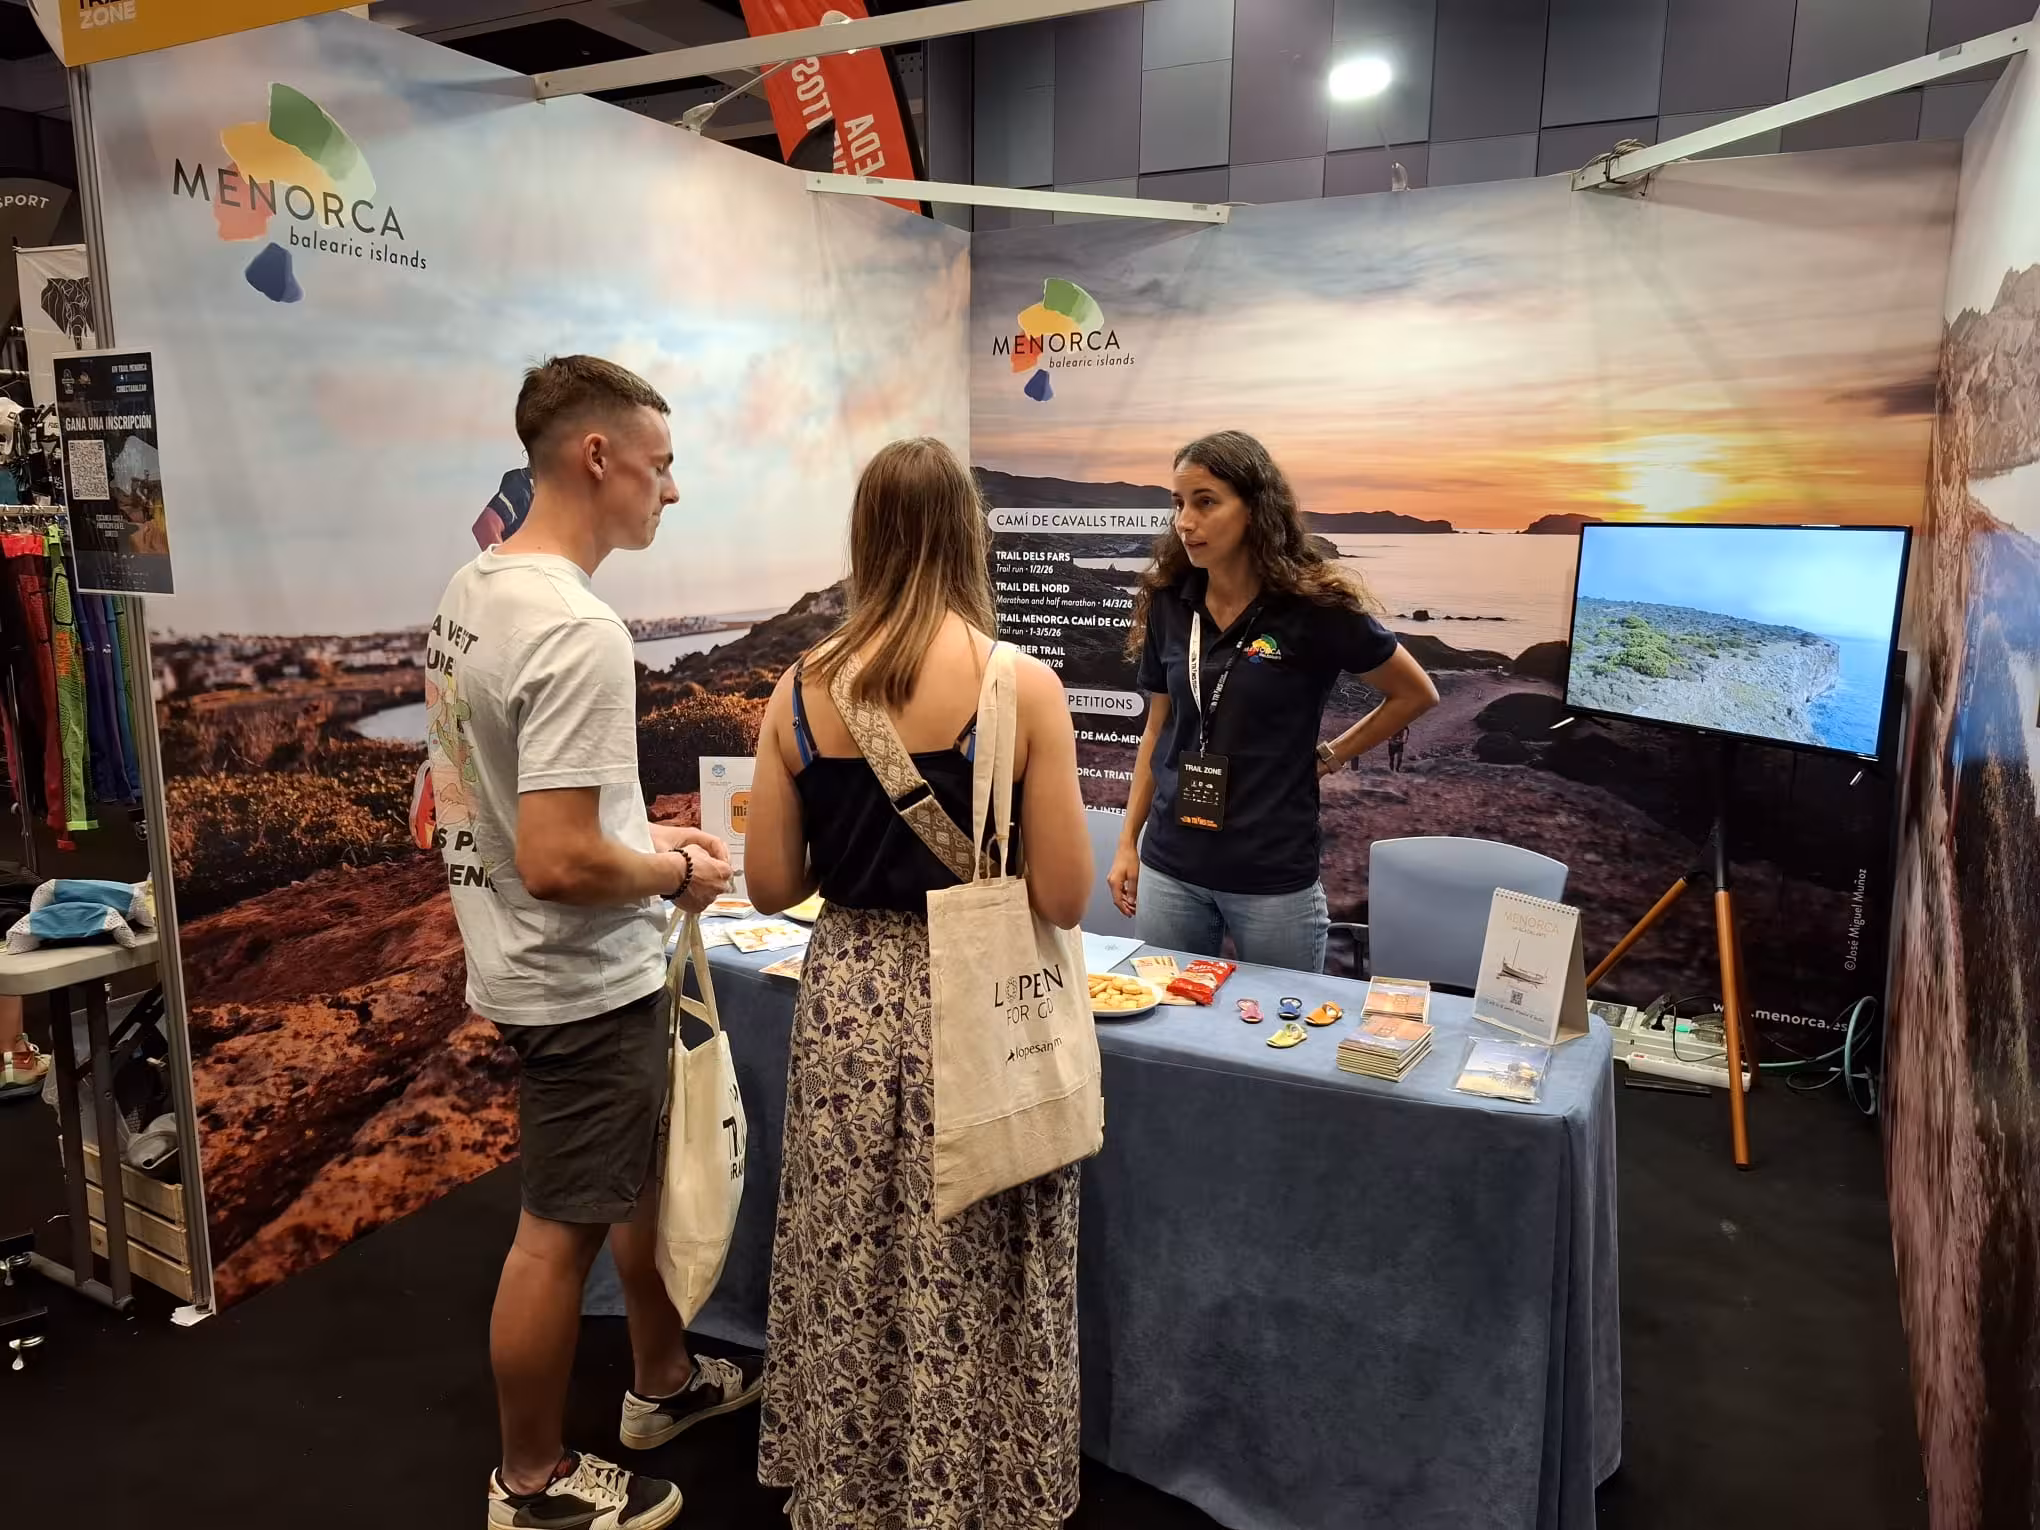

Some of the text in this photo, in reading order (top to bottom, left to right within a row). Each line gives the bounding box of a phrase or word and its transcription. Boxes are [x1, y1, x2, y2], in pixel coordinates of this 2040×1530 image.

[80, 1, 136, 30] ZONE
[173, 158, 405, 240] MENORCA
[290, 226, 427, 269] balearic islands
[992, 330, 1120, 356] MENORCA
[1049, 353, 1135, 368] balearic islands
[65, 411, 152, 431] GANA UNA INSCRIPCIÓN
[996, 512, 1169, 528] CAMÍ DE CAVALLS TRAIL RA
[995, 551, 1071, 562] TRAIL DELS FARS
[996, 563, 1011, 573] Trail
[1030, 564, 1054, 574] 1/2/26
[995, 582, 1070, 593] TRAIL DEL NORD
[996, 594, 1133, 609] Marathon and half marathon 14/3/26
[996, 613, 1021, 623] TRAIL
[1023, 614, 1070, 625] MENORCA
[1071, 614, 1096, 626] CAMÍ
[1098, 617, 1111, 627] DE
[995, 625, 1061, 637] Trail run 1-3/5/26
[1039, 645, 1066, 656] TRAIL
[1068, 694, 1133, 710] PETITIONS
[1074, 730, 1143, 744] T DE MAÓ-MEN
[1076, 767, 1103, 778] ORCA
[1184, 763, 1223, 776] TRAIL ZONE
[1851, 868, 1867, 902] Muñoz
[1847, 904, 1865, 938] Miguel
[1006, 1004, 1030, 1026] FOR
